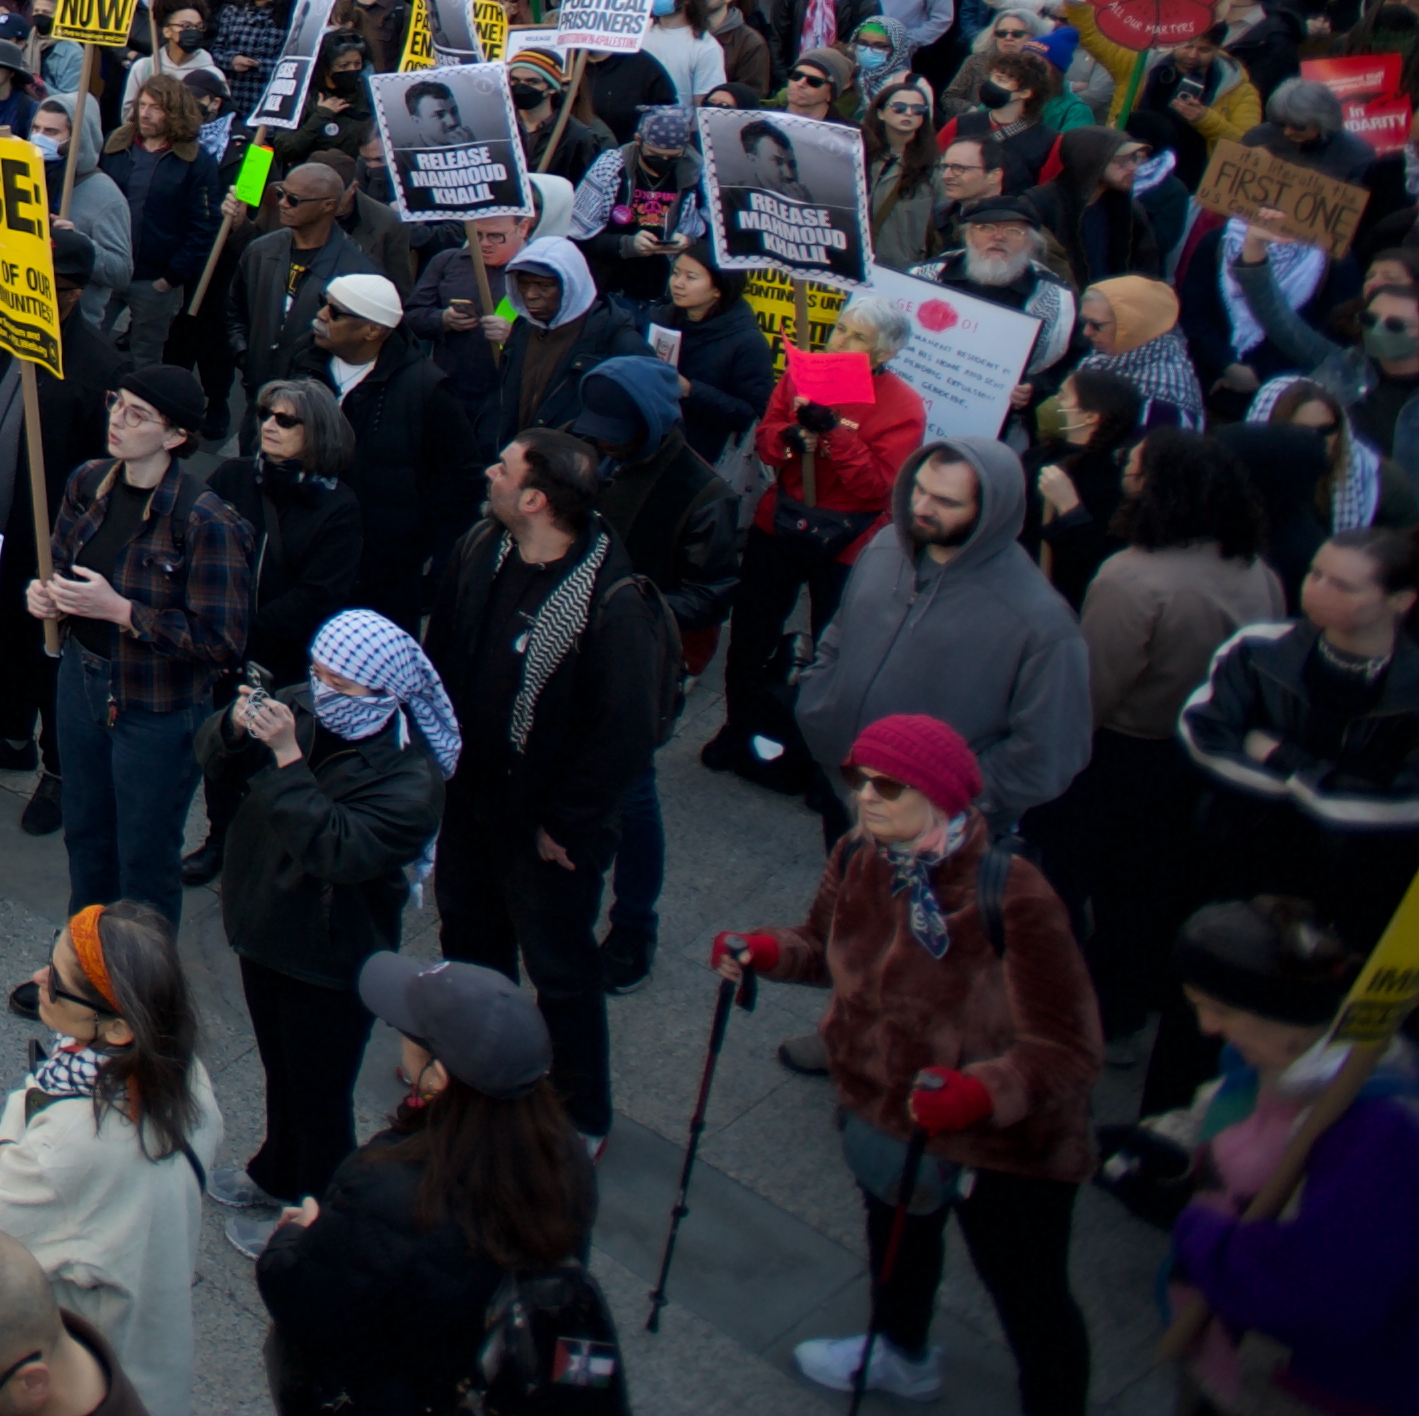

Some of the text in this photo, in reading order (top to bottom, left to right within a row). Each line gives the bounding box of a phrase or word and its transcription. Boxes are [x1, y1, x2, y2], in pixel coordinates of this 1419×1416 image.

[560, 11, 645, 34] PRISONERS
[1145, 21, 1195, 34] MARTYRS
[416, 146, 491, 170] RELEASE
[411, 163, 508, 187] MAHMOUD
[433, 184, 495, 204] KHALIL
[1213, 160, 1360, 235] FIRST ONE
[750, 193, 832, 228] RELEASE
[738, 211, 847, 250] MAHMOUD
[762, 232, 832, 264] KHALIL
[2, 261, 19, 285] OF
[26, 267, 51, 300] OUR
